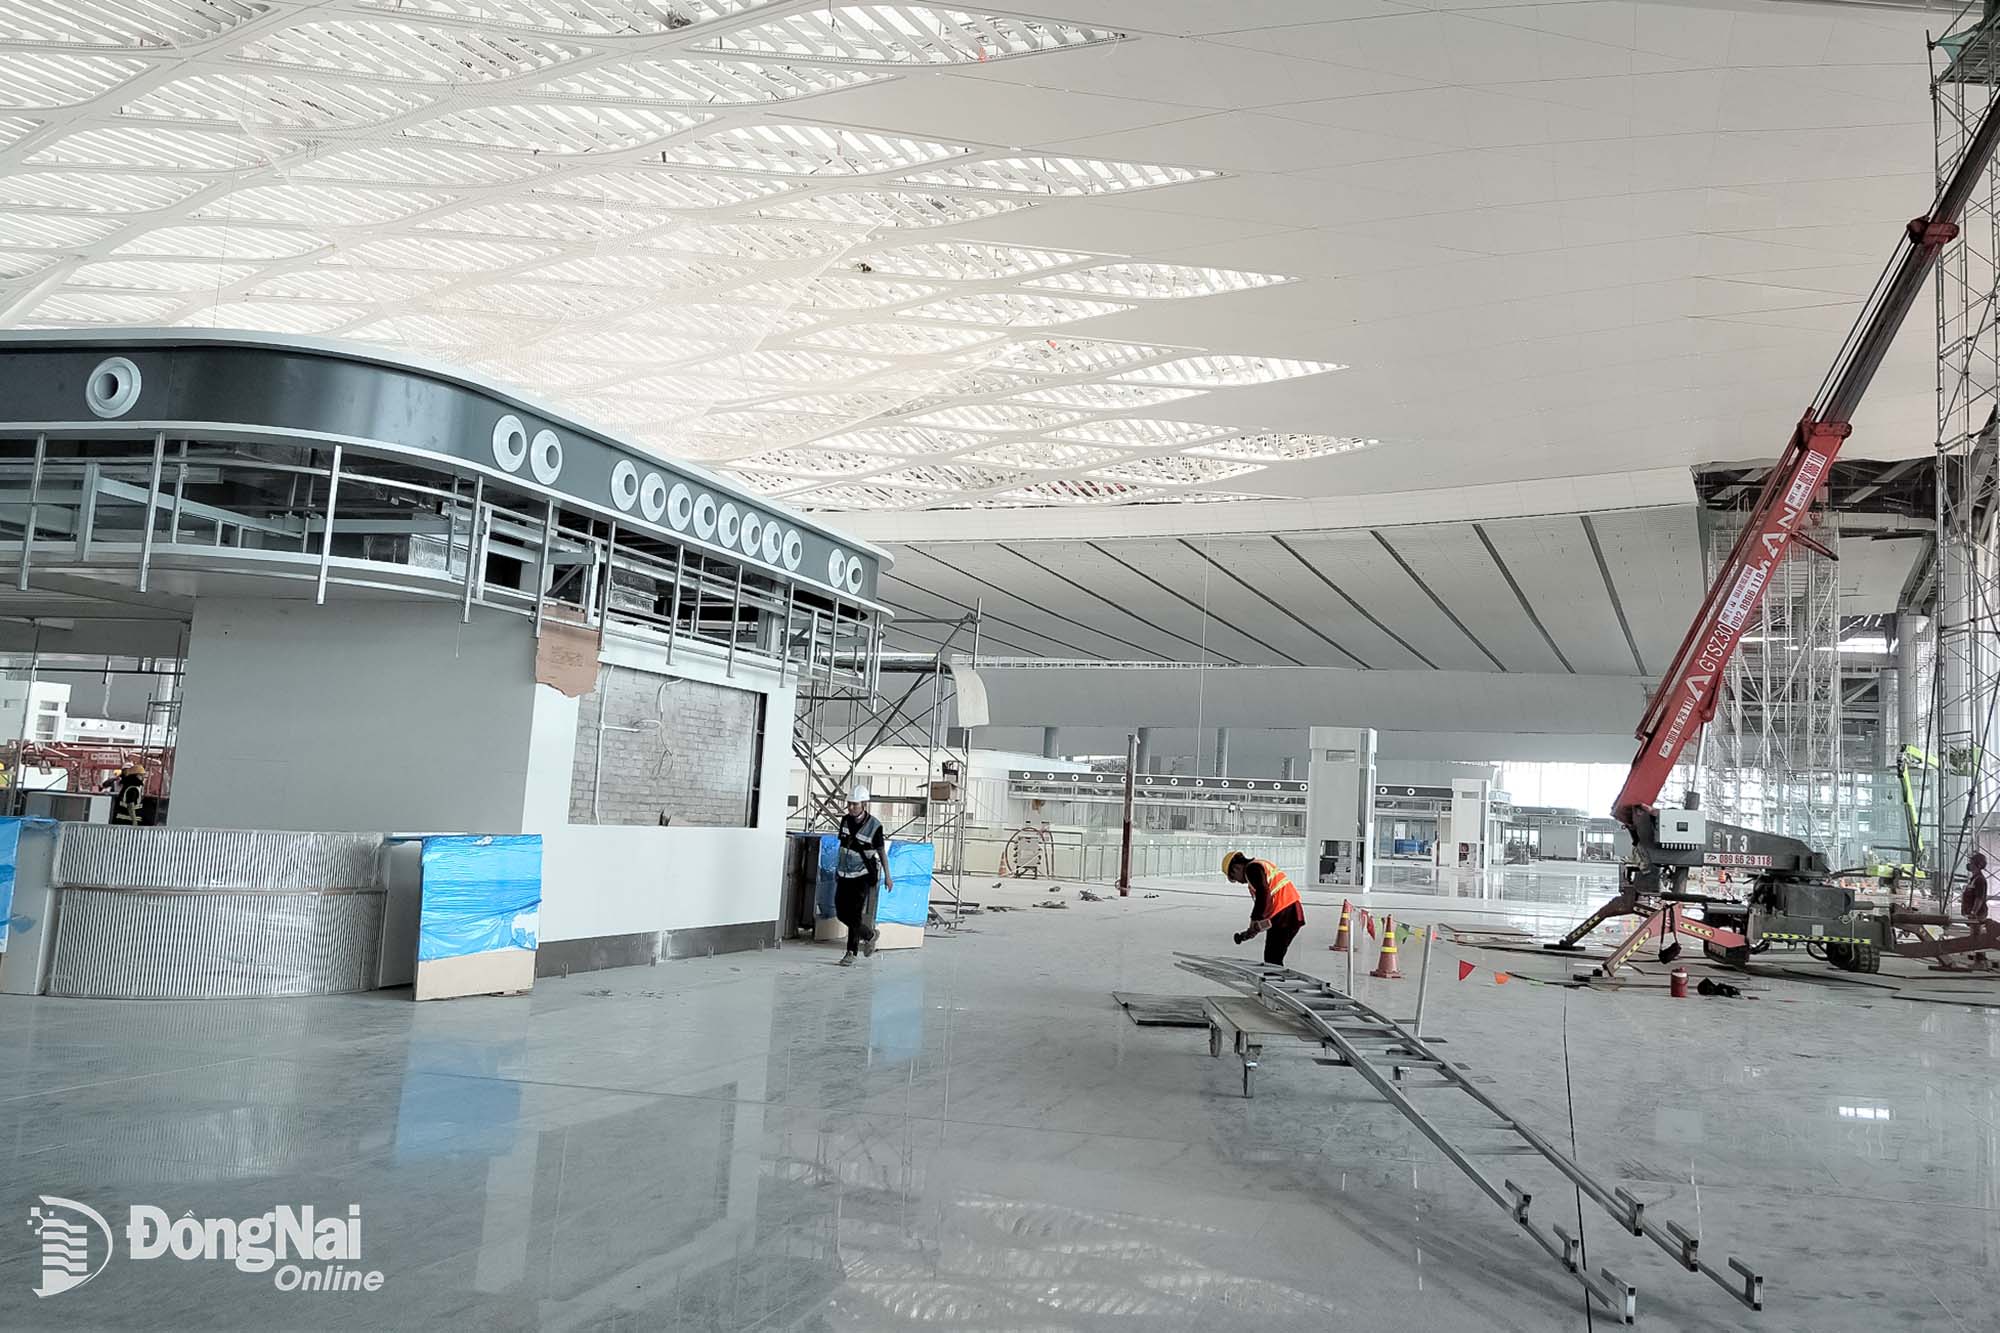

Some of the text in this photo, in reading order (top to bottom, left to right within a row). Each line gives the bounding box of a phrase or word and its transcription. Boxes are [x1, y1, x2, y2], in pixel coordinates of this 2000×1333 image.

[1731, 611, 1744, 628] 092
[1740, 589, 1756, 611] 8866
[1751, 571, 1765, 590] 118
[1699, 623, 1734, 673] GTSZ30
[1719, 854, 1733, 864] 089
[1735, 855, 1744, 864] 66
[1746, 855, 1755, 865] 29
[1757, 856, 1771, 866] 118
